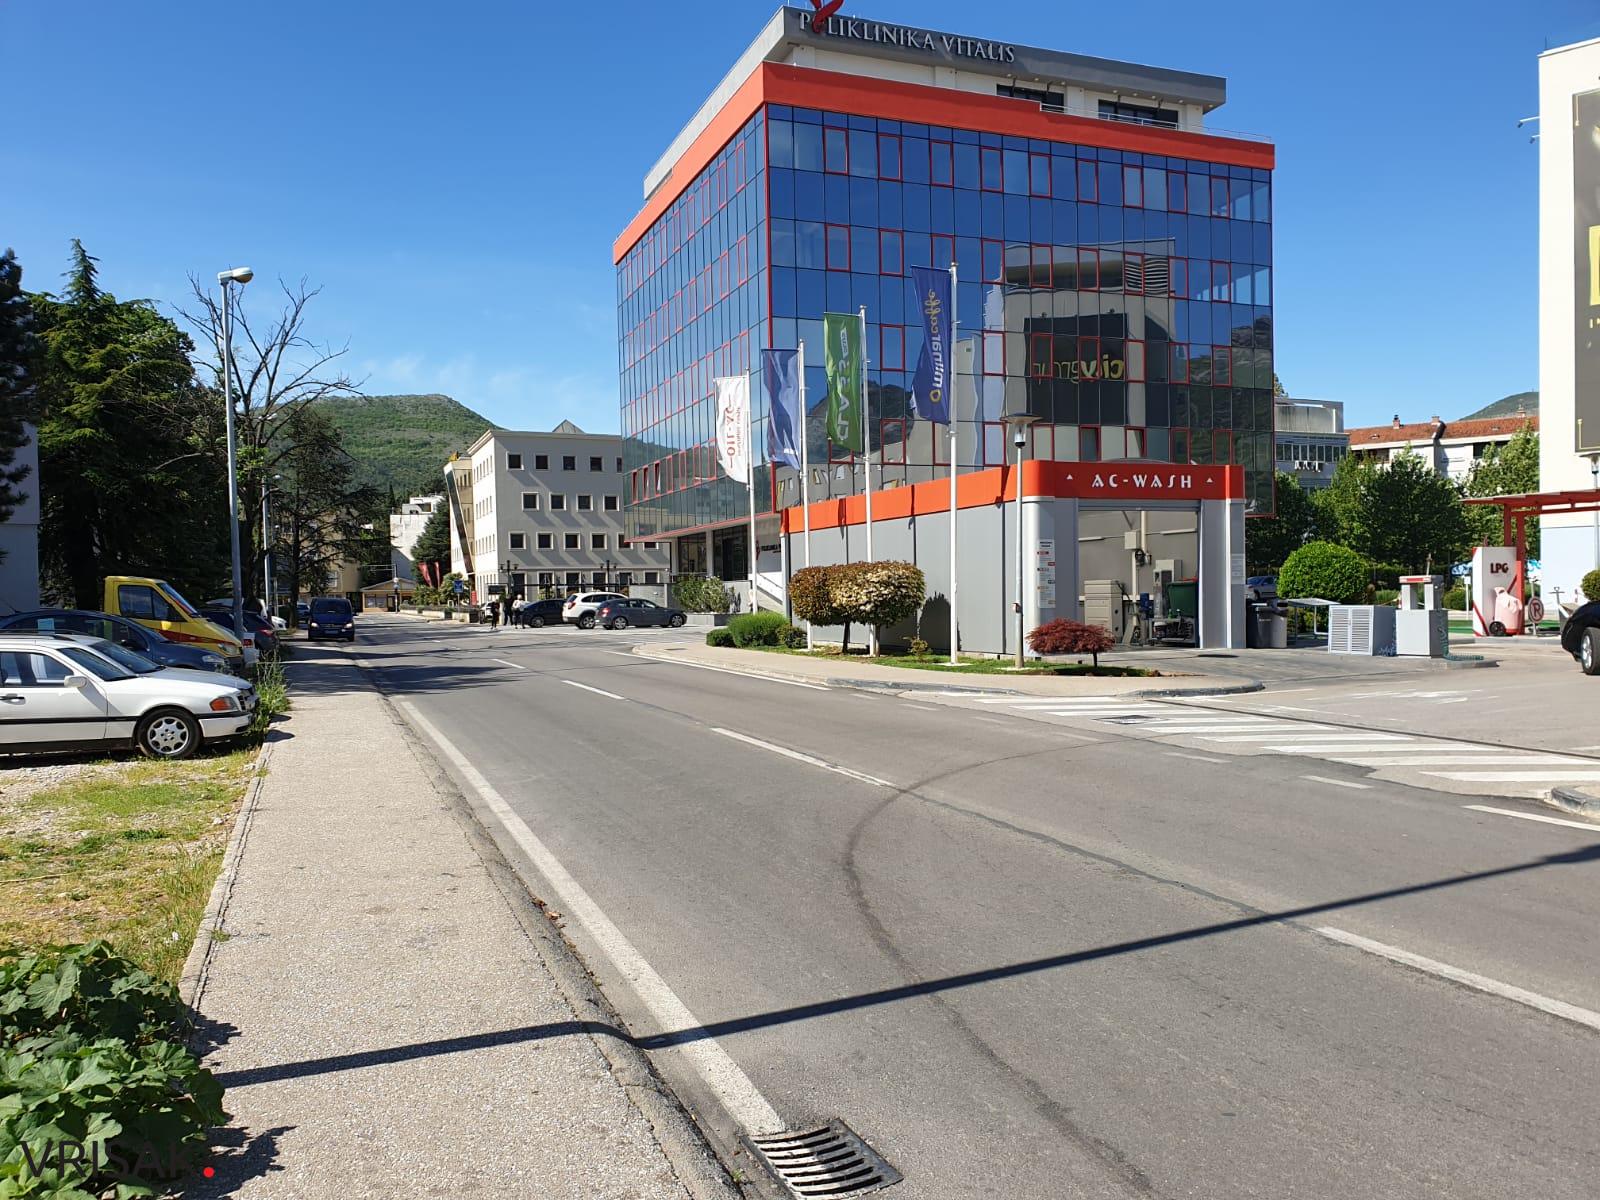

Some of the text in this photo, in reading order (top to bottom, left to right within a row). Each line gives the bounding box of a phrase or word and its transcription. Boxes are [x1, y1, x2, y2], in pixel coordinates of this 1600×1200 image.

[941, 35, 1016, 63] VITALIS
[1091, 474, 1193, 489] AC-WASH
[1490, 562, 1509, 574] LPG
